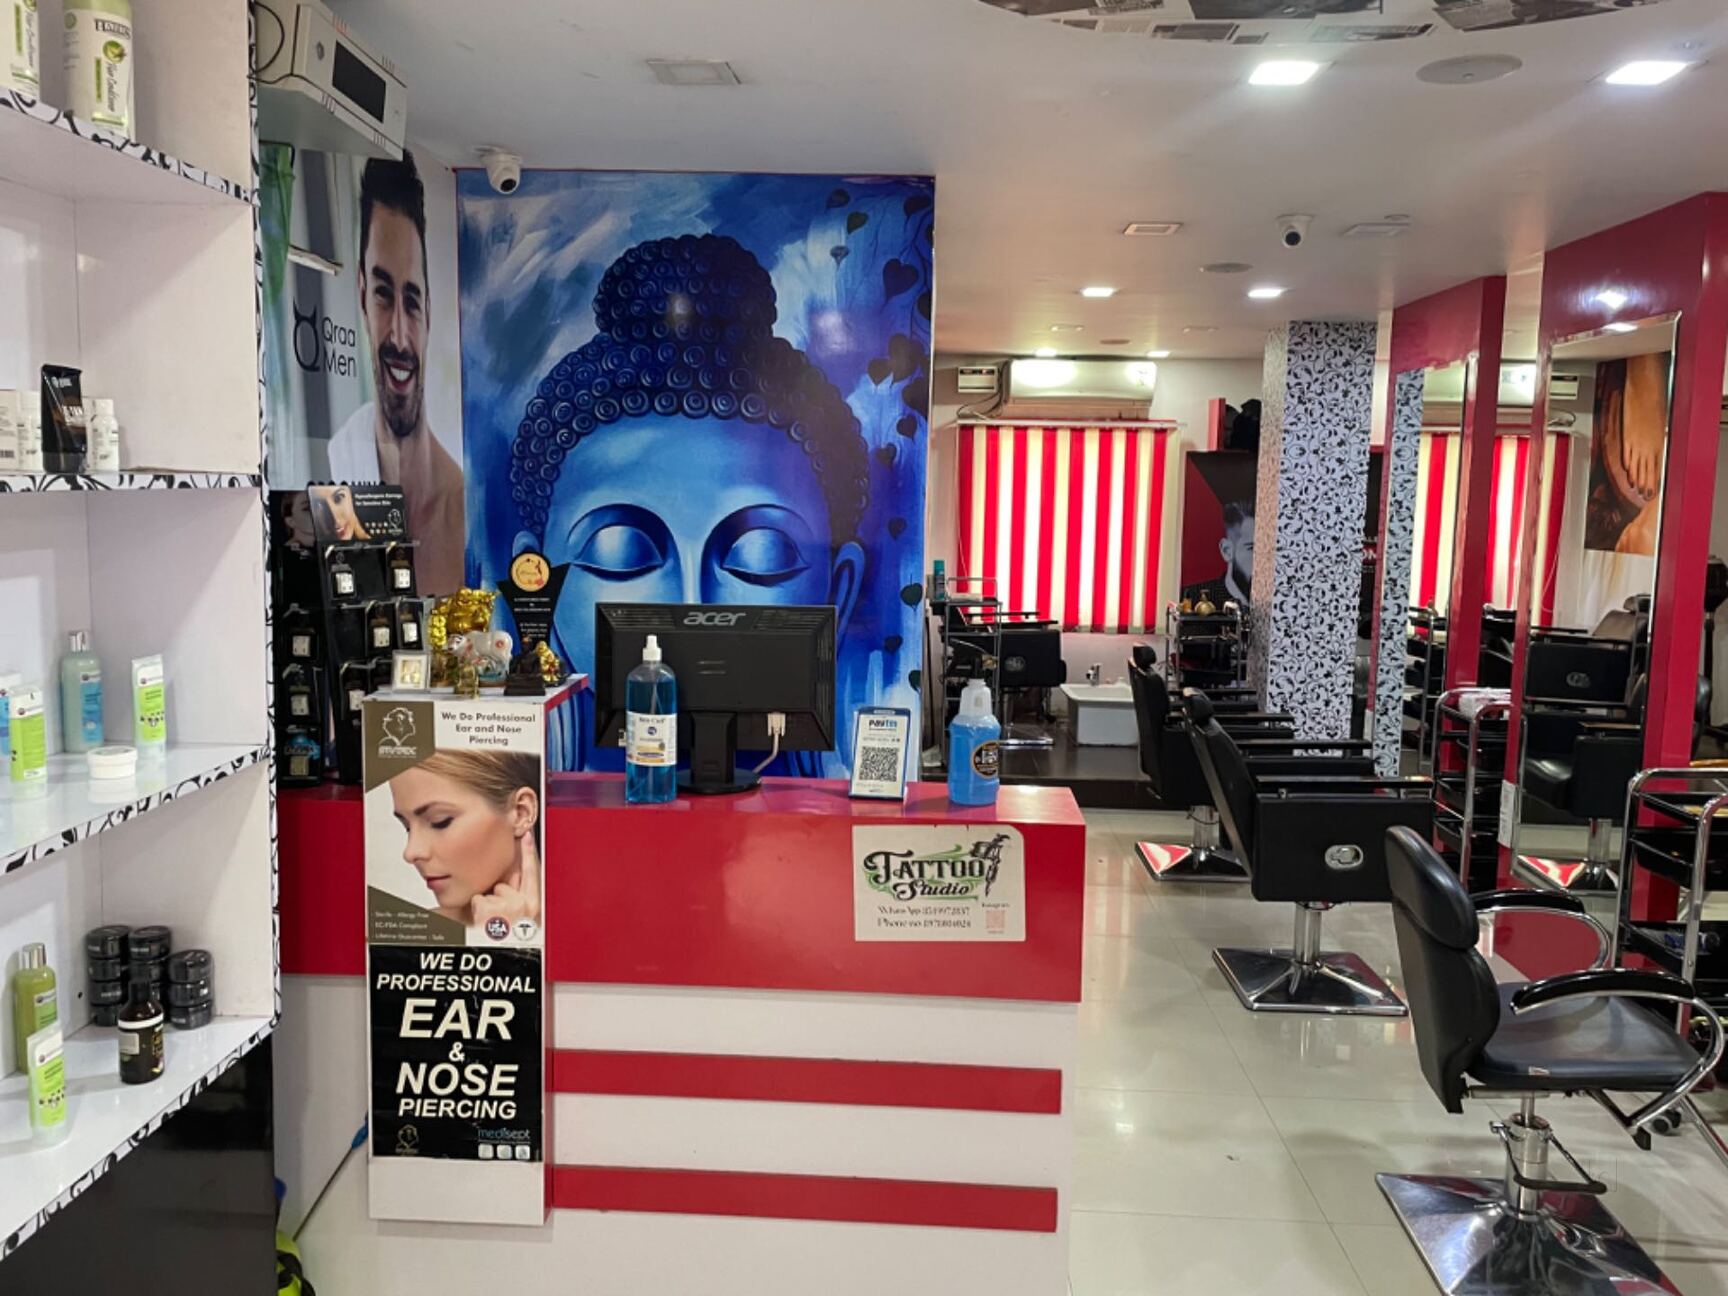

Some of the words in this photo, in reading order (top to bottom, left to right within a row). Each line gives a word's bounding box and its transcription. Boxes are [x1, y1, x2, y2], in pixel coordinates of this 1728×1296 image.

[321, 316, 356, 348] Qraa
[323, 344, 357, 377] Men
[683, 611, 746, 626] acer
[441, 712, 456, 720] We
[459, 712, 473, 720] Do
[476, 712, 536, 722] Professional
[456, 724, 471, 733] Ear
[474, 724, 495, 733] and
[496, 725, 522, 733] Nose
[469, 736, 509, 746] Piercing
[892, 879, 970, 901] Studio
[420, 953, 454, 970] WE
[460, 954, 492, 971] DO
[376, 974, 536, 993] PROFESSIONAL
[399, 998, 515, 1040] EAR
[449, 1042, 465, 1062] &
[396, 1062, 519, 1097] NOSE
[398, 1098, 517, 1120] PIERCING
